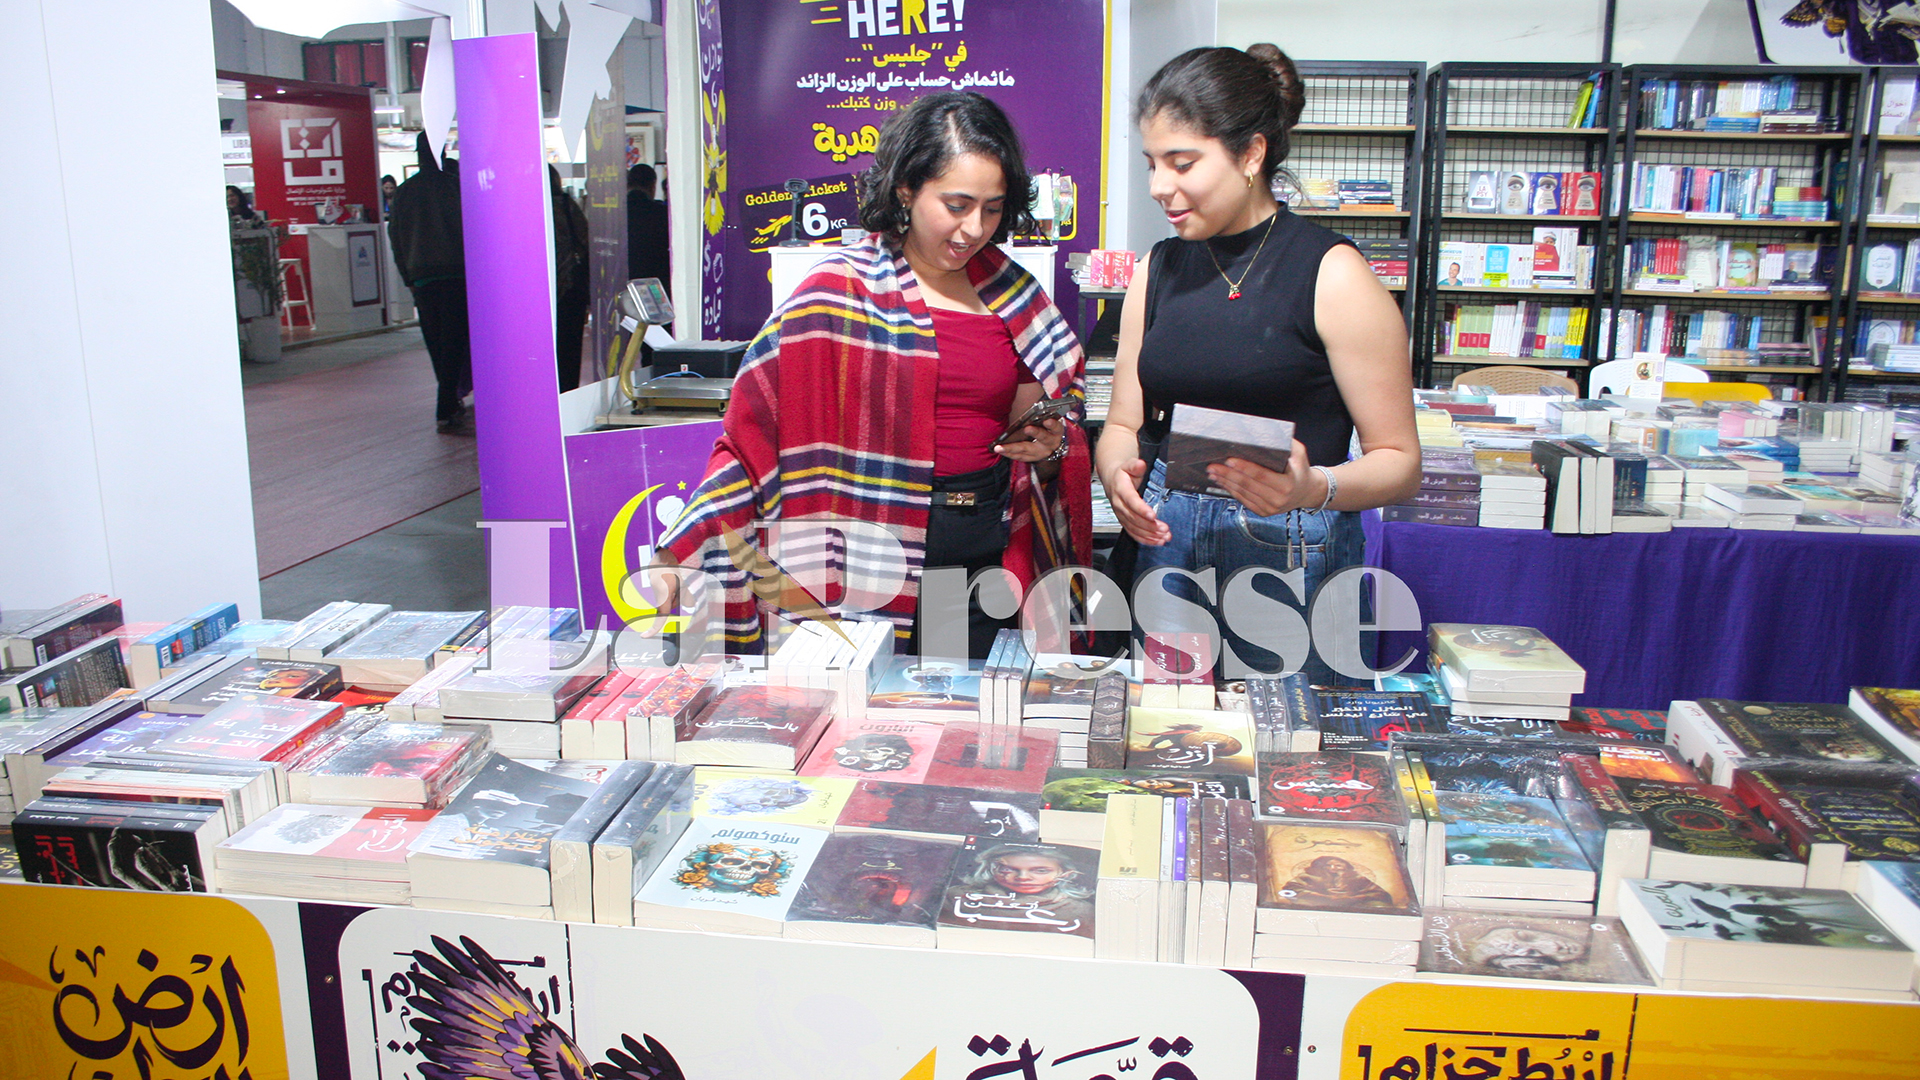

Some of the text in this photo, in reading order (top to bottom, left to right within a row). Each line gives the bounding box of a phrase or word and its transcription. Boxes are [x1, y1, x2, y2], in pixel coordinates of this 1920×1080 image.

[848, 0, 965, 38] HERE!
[944, 40, 968, 72] في
[796, 72, 836, 93] الزائد
[836, 72, 876, 92] الوزن
[876, 72, 903, 92] على
[904, 71, 951, 91] حساب
[874, 97, 896, 111] وزن
[804, 180, 848, 198] icket
[803, 202, 848, 236] 6 KG
